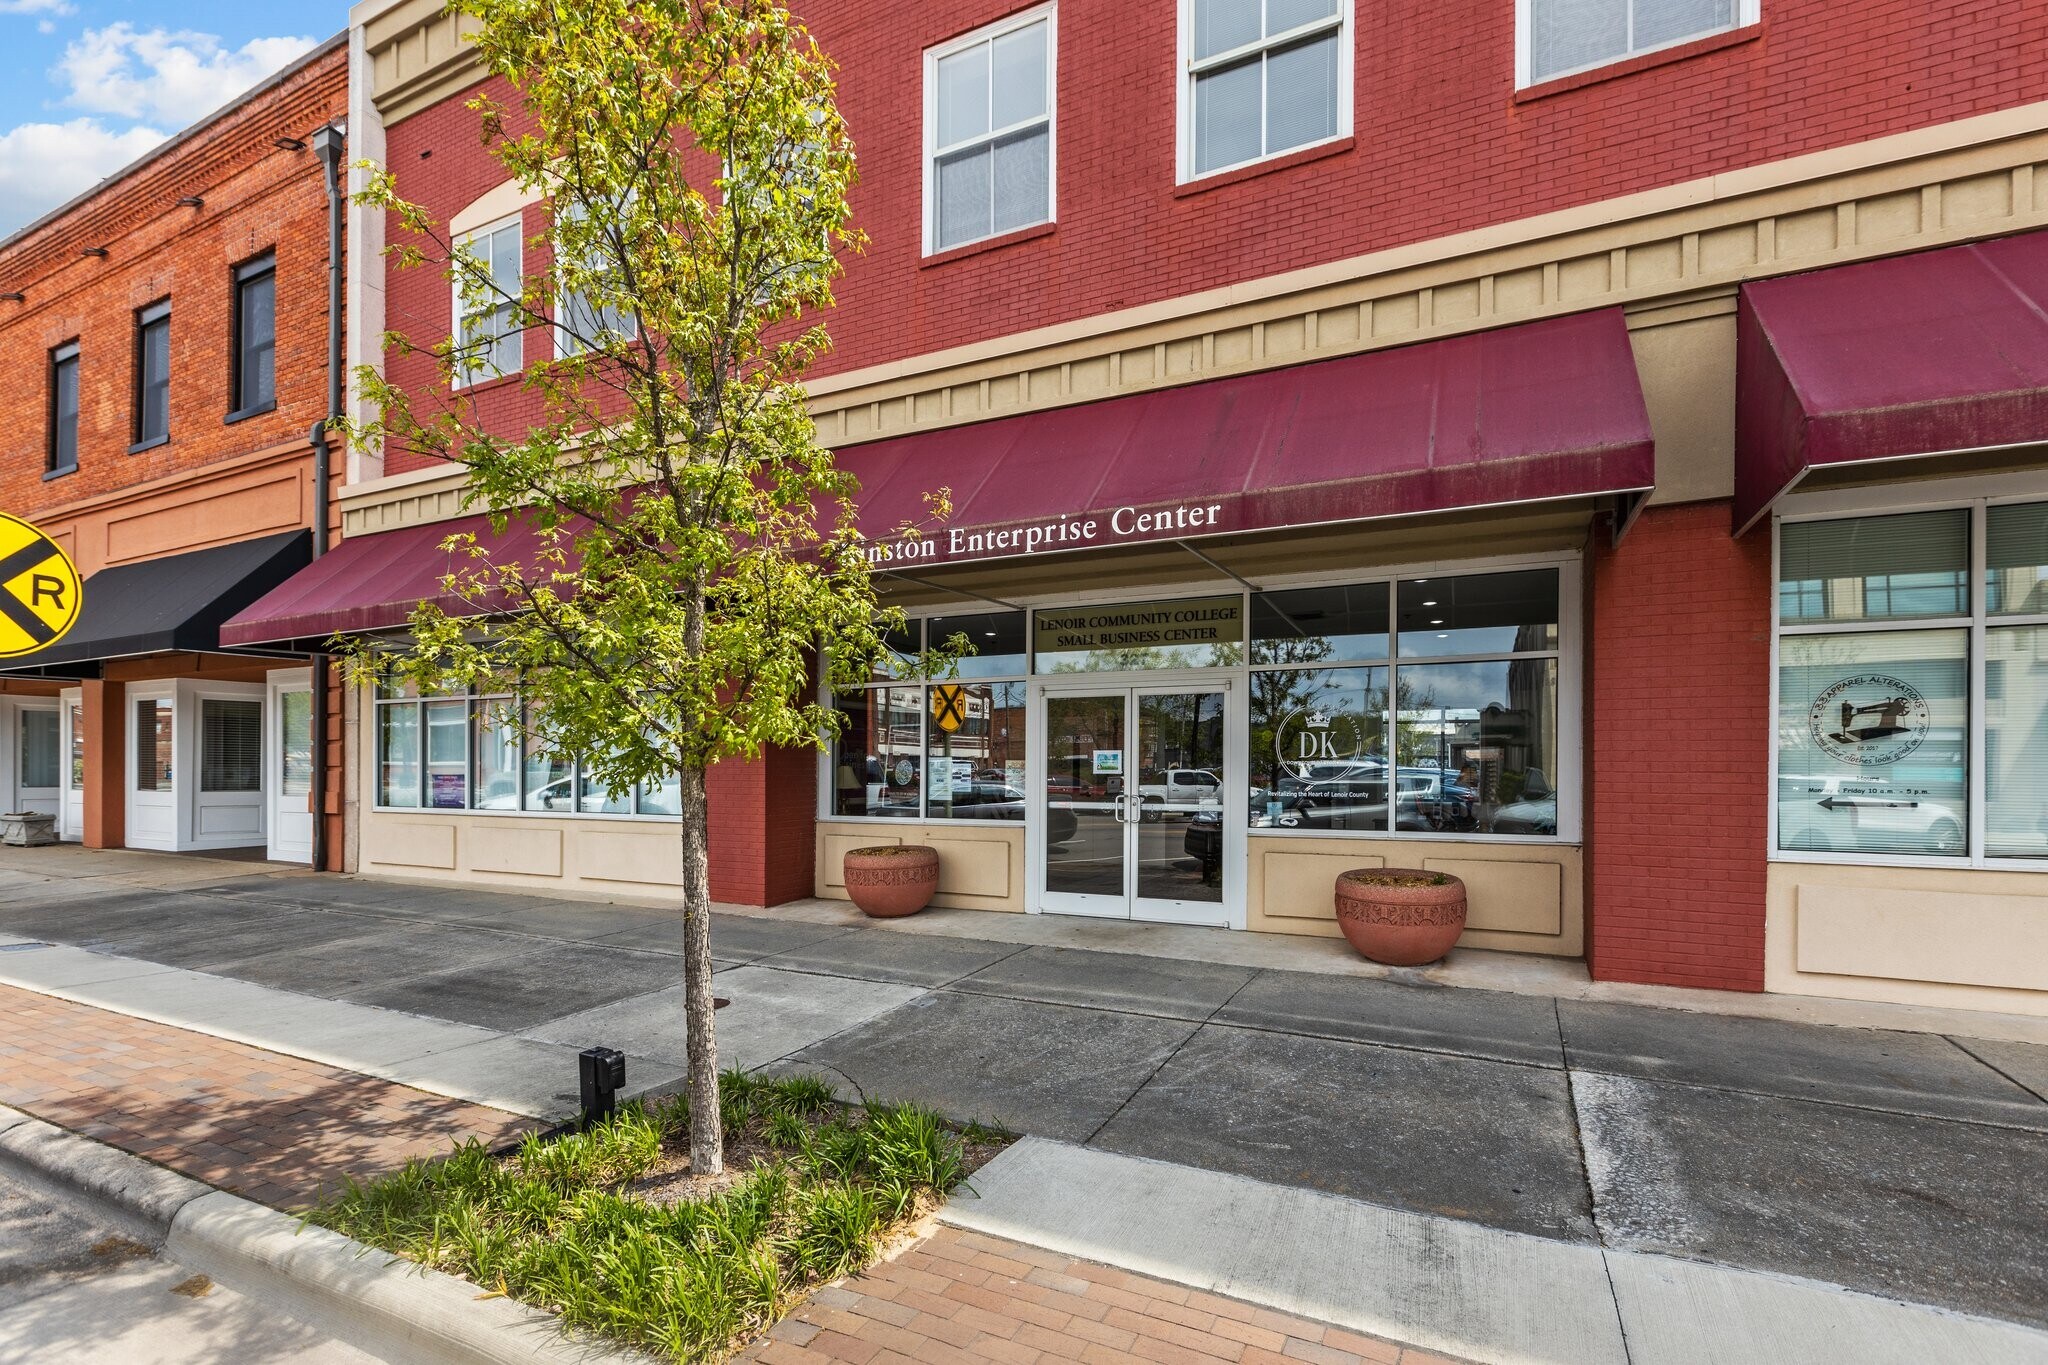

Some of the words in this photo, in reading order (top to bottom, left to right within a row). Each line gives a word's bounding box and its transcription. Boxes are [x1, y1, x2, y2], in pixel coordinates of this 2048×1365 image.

[841, 537, 936, 567] nston
[948, 514, 1097, 554] Enterprise
[1111, 504, 1222, 535] Center
[32, 573, 66, 610] R
[1040, 616, 1086, 631] LENOIR
[1089, 612, 1172, 628] COMMUNITY
[1174, 607, 1238, 623] COLLEGE
[1057, 634, 1097, 647] SMALL
[1100, 630, 1161, 645] BUSINESS
[1164, 627, 1218, 642] CENTER
[1827, 677, 1867, 698] APPAREL
[1869, 676, 1924, 709] ALTERATIONS
[1299, 731, 1338, 758] DK
[1825, 746, 1845, 758] your
[1844, 754, 1872, 764] clothes
[1875, 754, 1892, 764] look
[1894, 743, 1912, 759] good
[1267, 790, 1298, 798] Revitalizing
[1349, 791, 1369, 799] County
[1843, 787, 1866, 795] Friday
